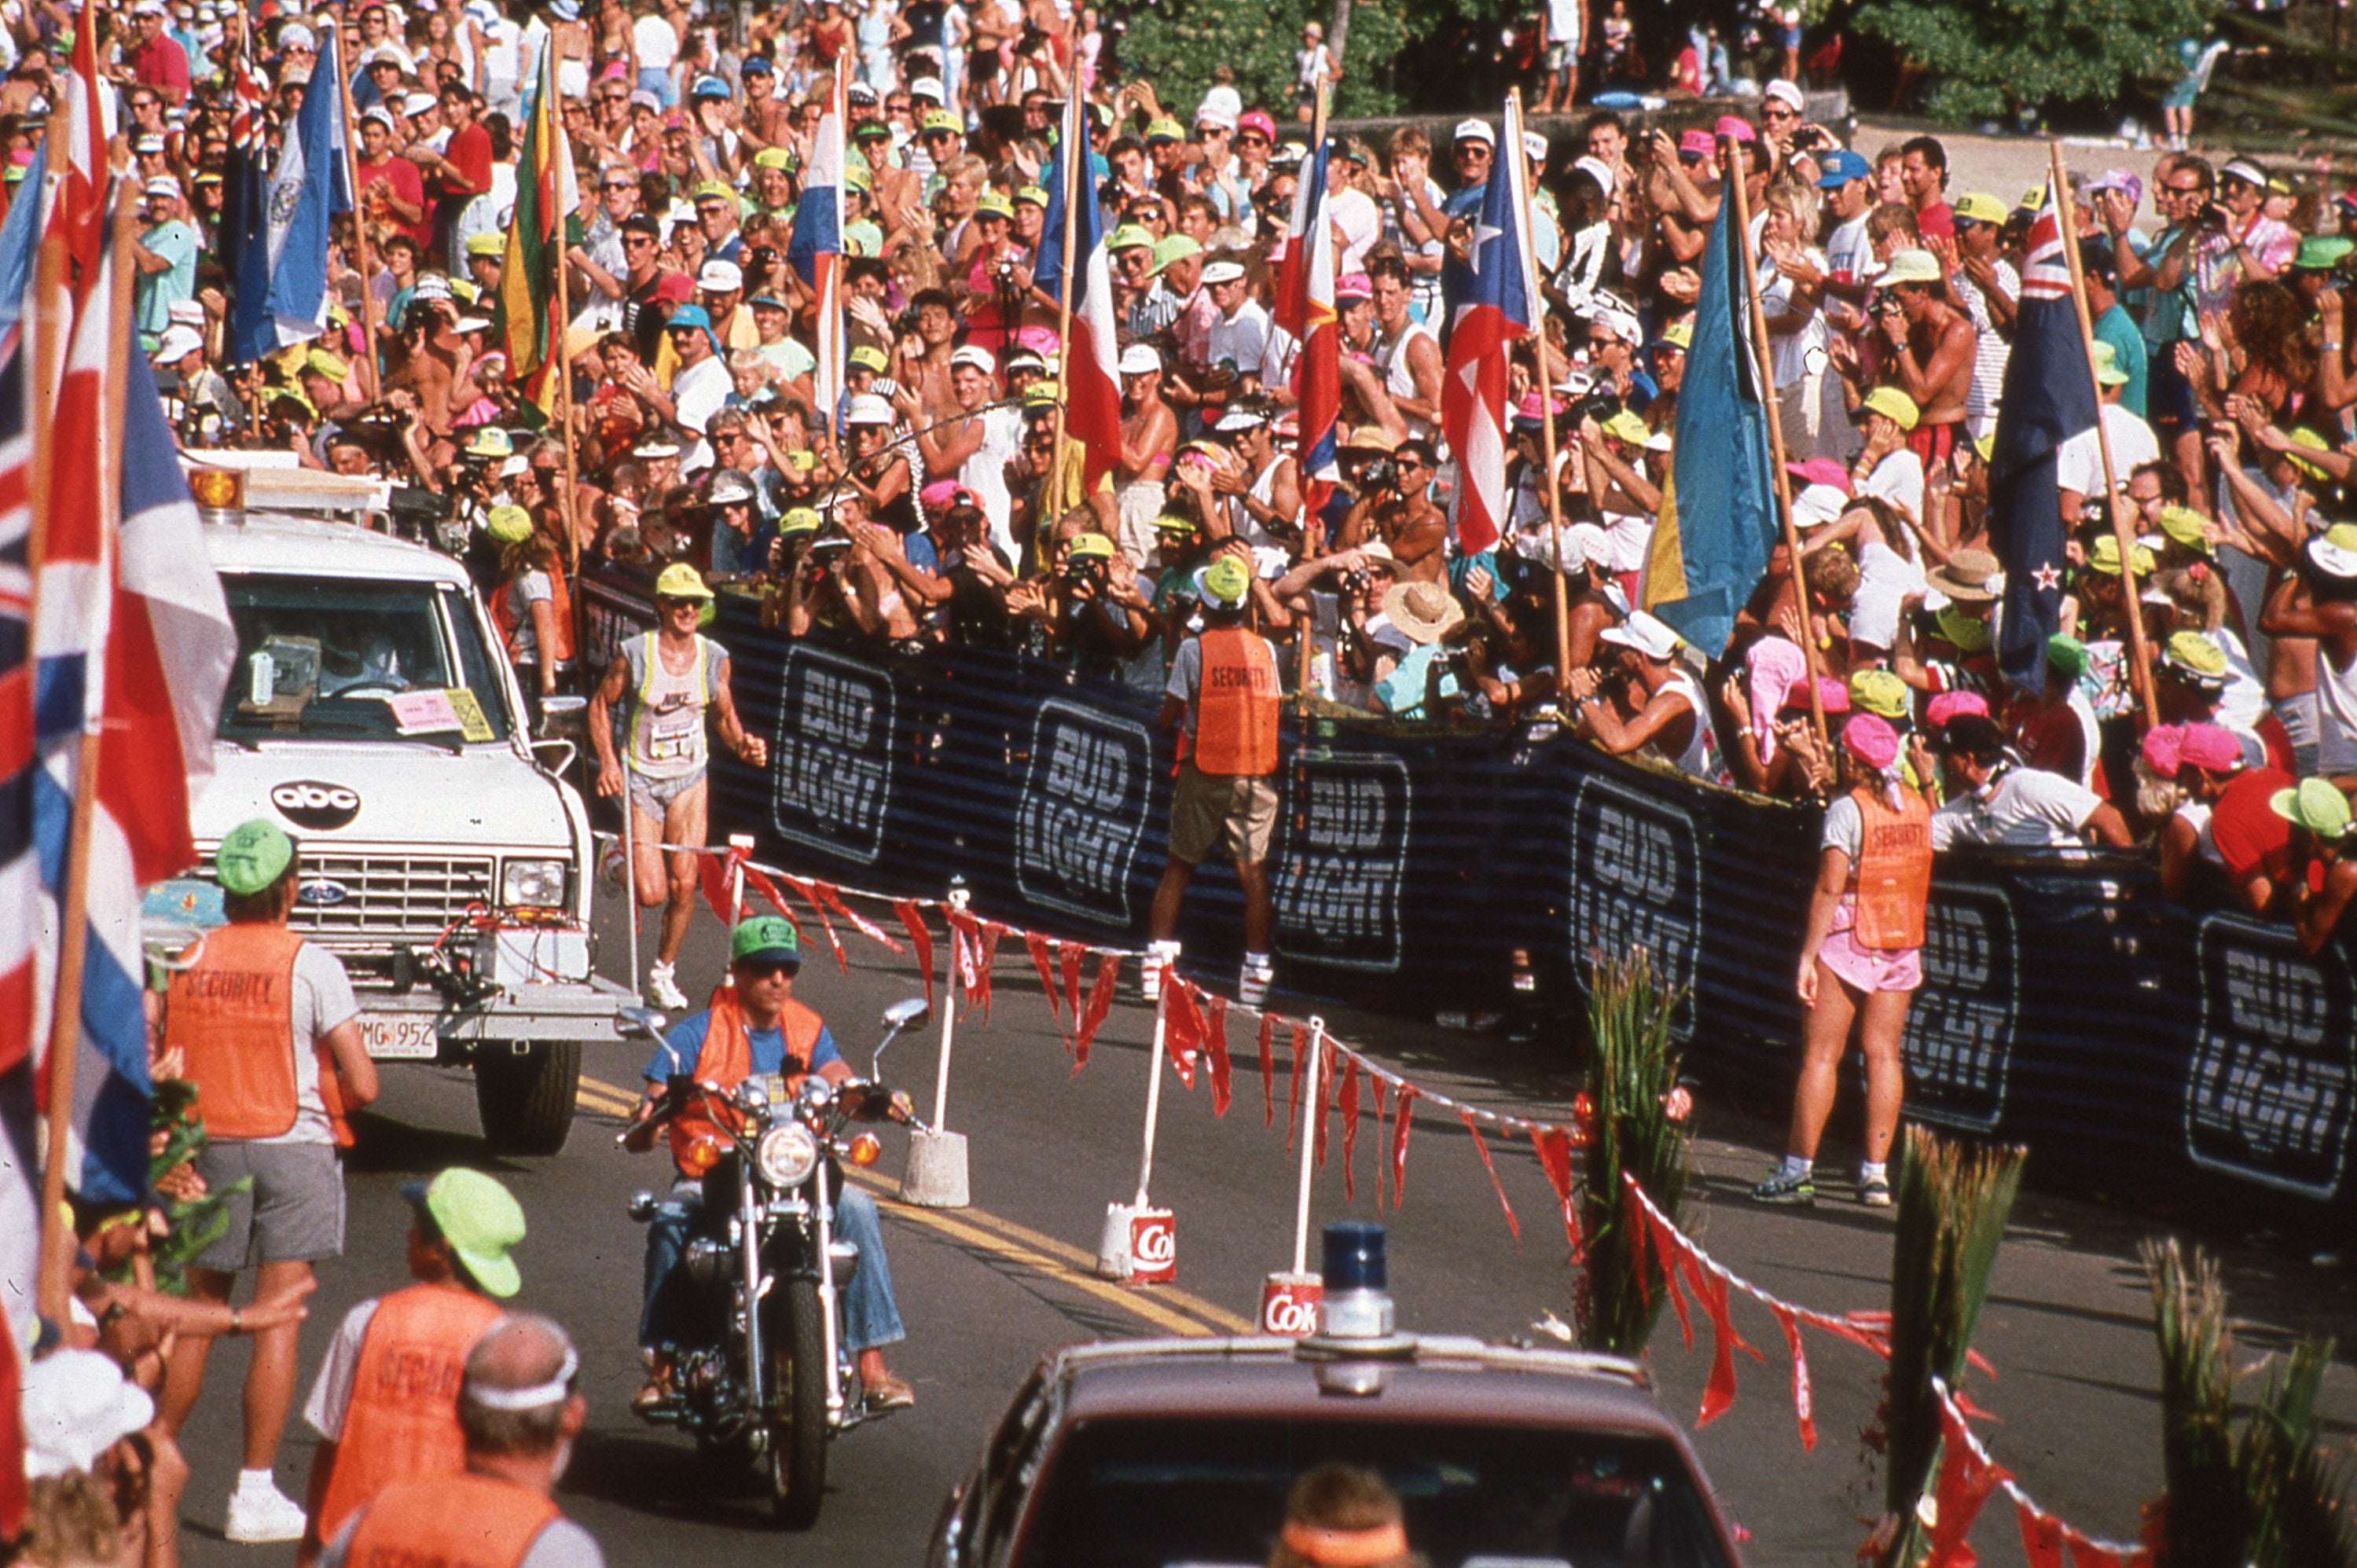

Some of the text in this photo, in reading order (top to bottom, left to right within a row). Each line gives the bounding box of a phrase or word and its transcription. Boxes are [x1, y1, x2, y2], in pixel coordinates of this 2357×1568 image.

[660, 692, 695, 707] NIKE
[801, 669, 872, 749] BUD
[1211, 666, 1266, 689] SECURITY
[675, 741, 683, 756] 1
[782, 737, 883, 829] LIGHT
[1046, 724, 1129, 811] BUD
[273, 785, 358, 810] abc
[1309, 778, 1386, 853] BUD
[1023, 796, 1133, 893] LIGHT
[1594, 806, 1677, 905] BUD
[1279, 854, 1394, 936] LIGHT
[1922, 902, 1990, 990] UD
[185, 970, 271, 1004] SECURITY
[2226, 949, 2327, 1045] BUD
[357, 1022, 434, 1047] MG 952
[1899, 991, 2006, 1089] IGHT
[2197, 1036, 2346, 1154] LIGHT
[1265, 1294, 1316, 1333] Cok
